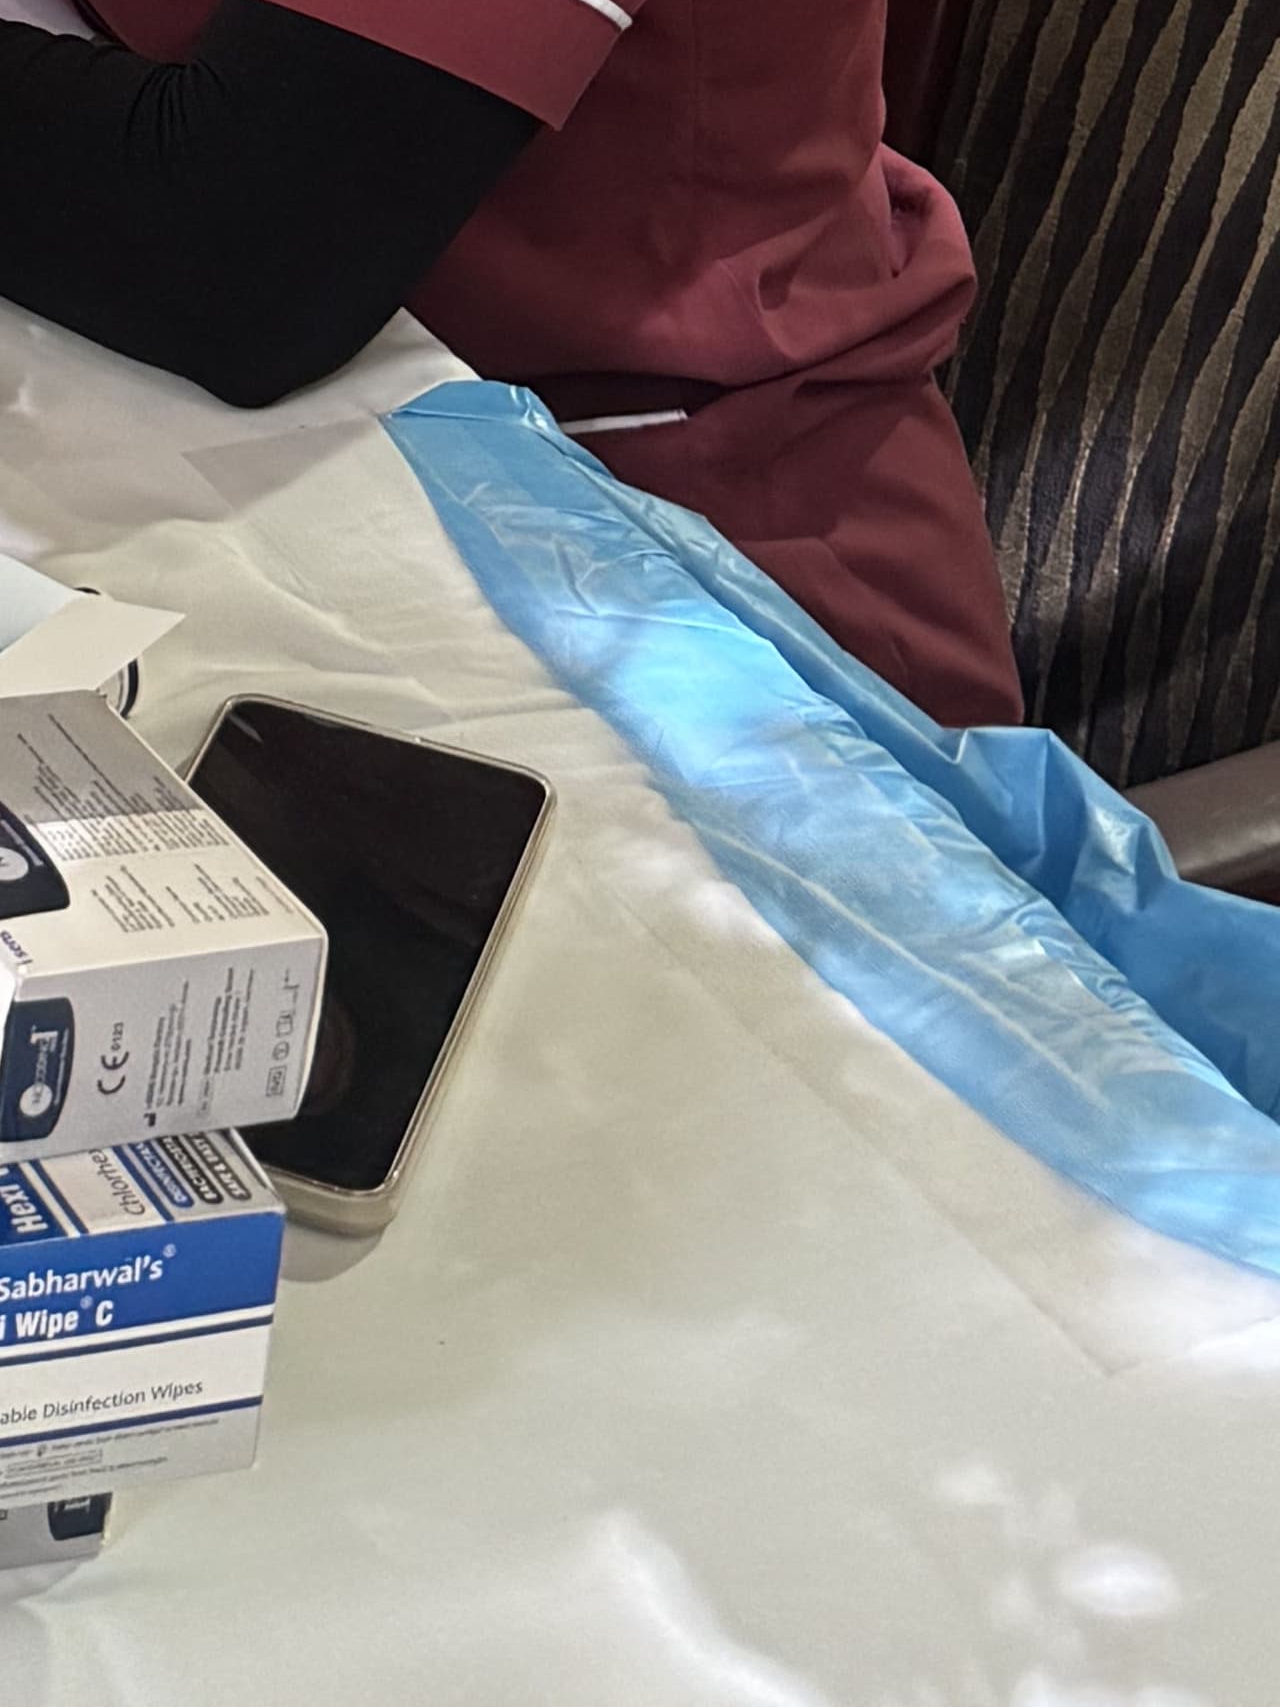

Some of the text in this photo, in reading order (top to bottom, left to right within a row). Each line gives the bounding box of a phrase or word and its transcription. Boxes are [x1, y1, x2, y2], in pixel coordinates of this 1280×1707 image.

[95, 1300, 113, 1328] C
[42, 1389, 146, 1419] Disinfection
[151, 1379, 204, 1402] Wipes
